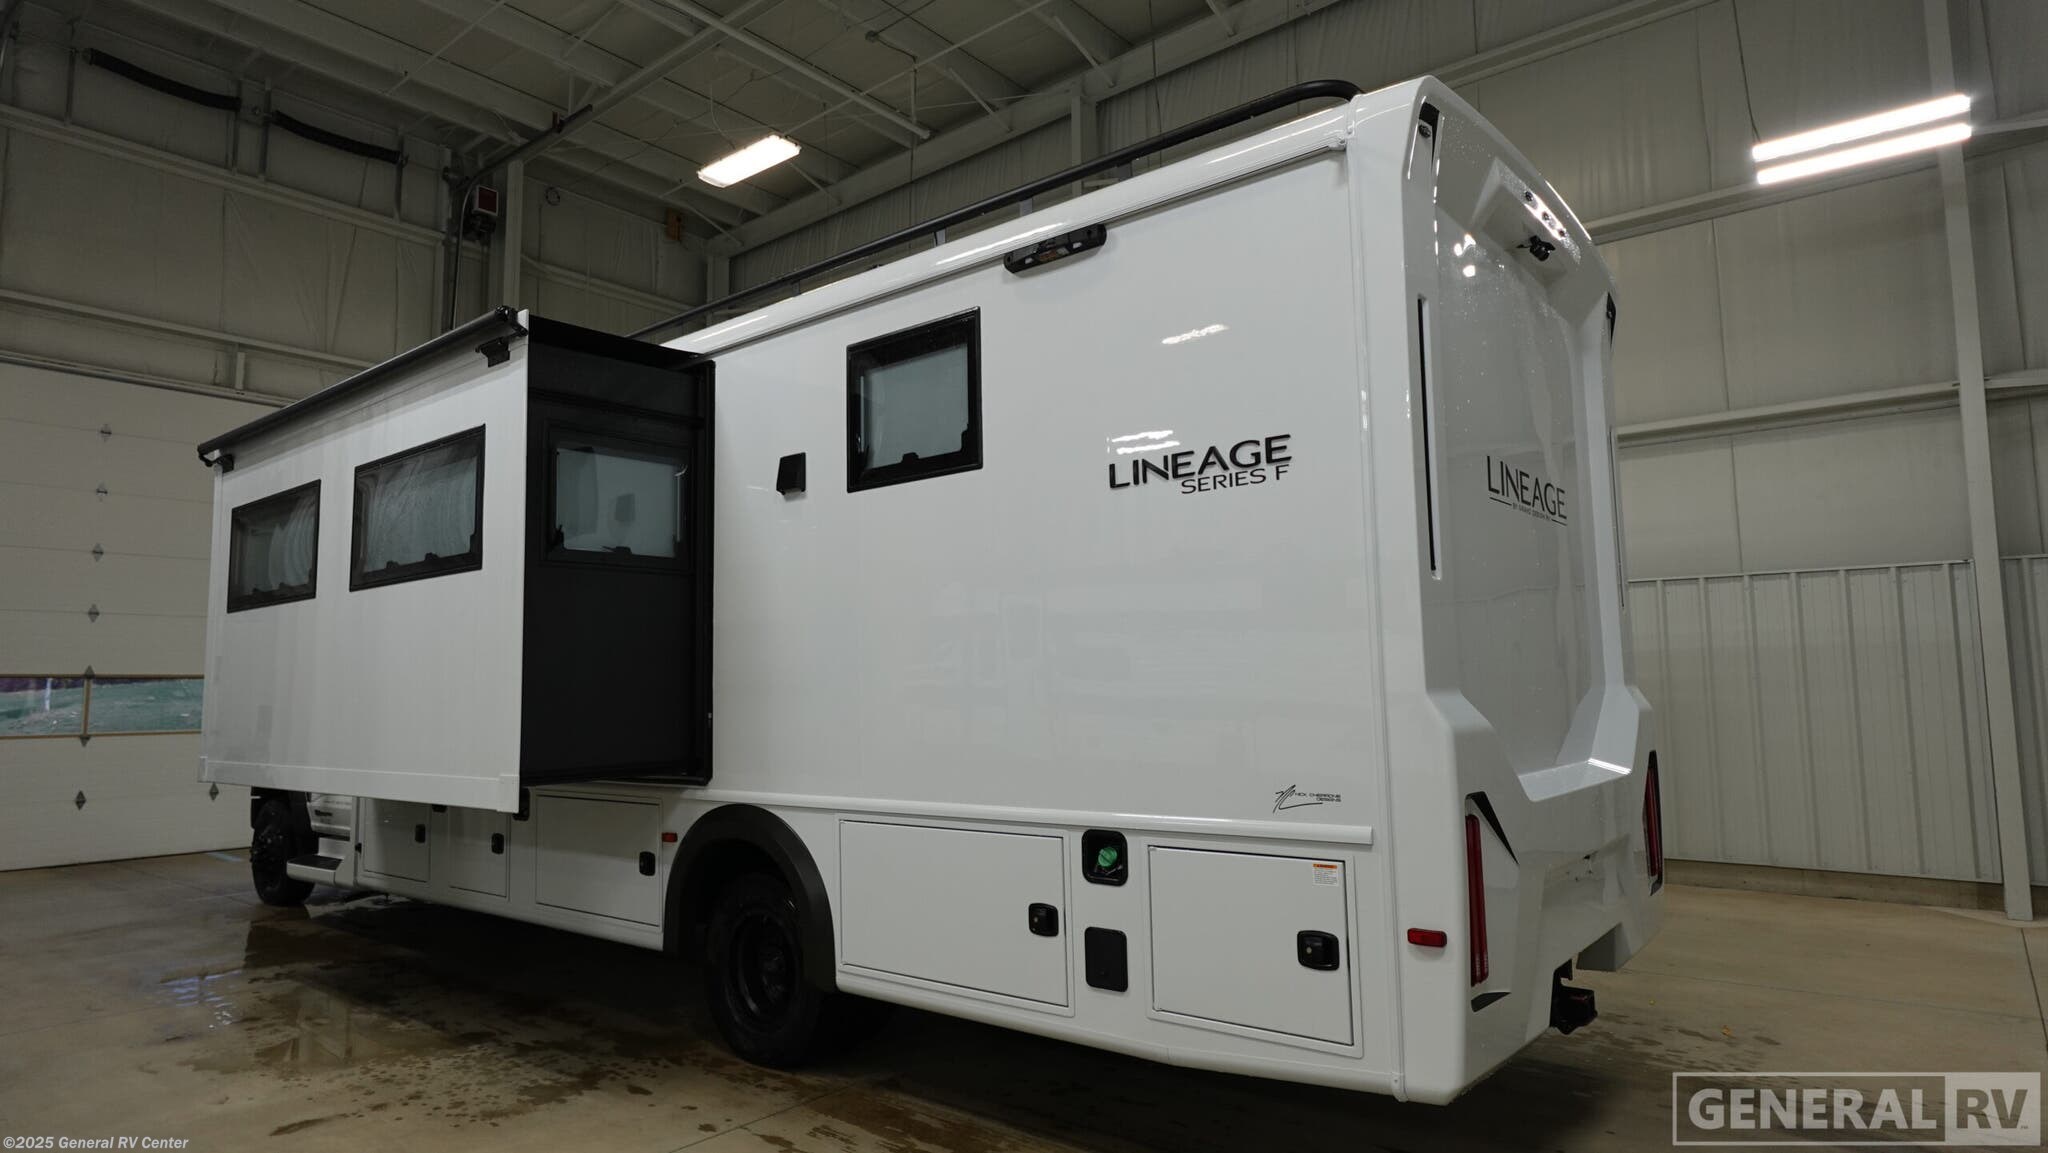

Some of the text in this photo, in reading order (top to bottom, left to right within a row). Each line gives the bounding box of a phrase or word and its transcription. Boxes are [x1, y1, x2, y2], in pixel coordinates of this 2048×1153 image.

[1109, 434, 1292, 489] LINEAGE
[1181, 464, 1290, 494] SERIES F
[1486, 455, 1568, 520] LINEAGE
